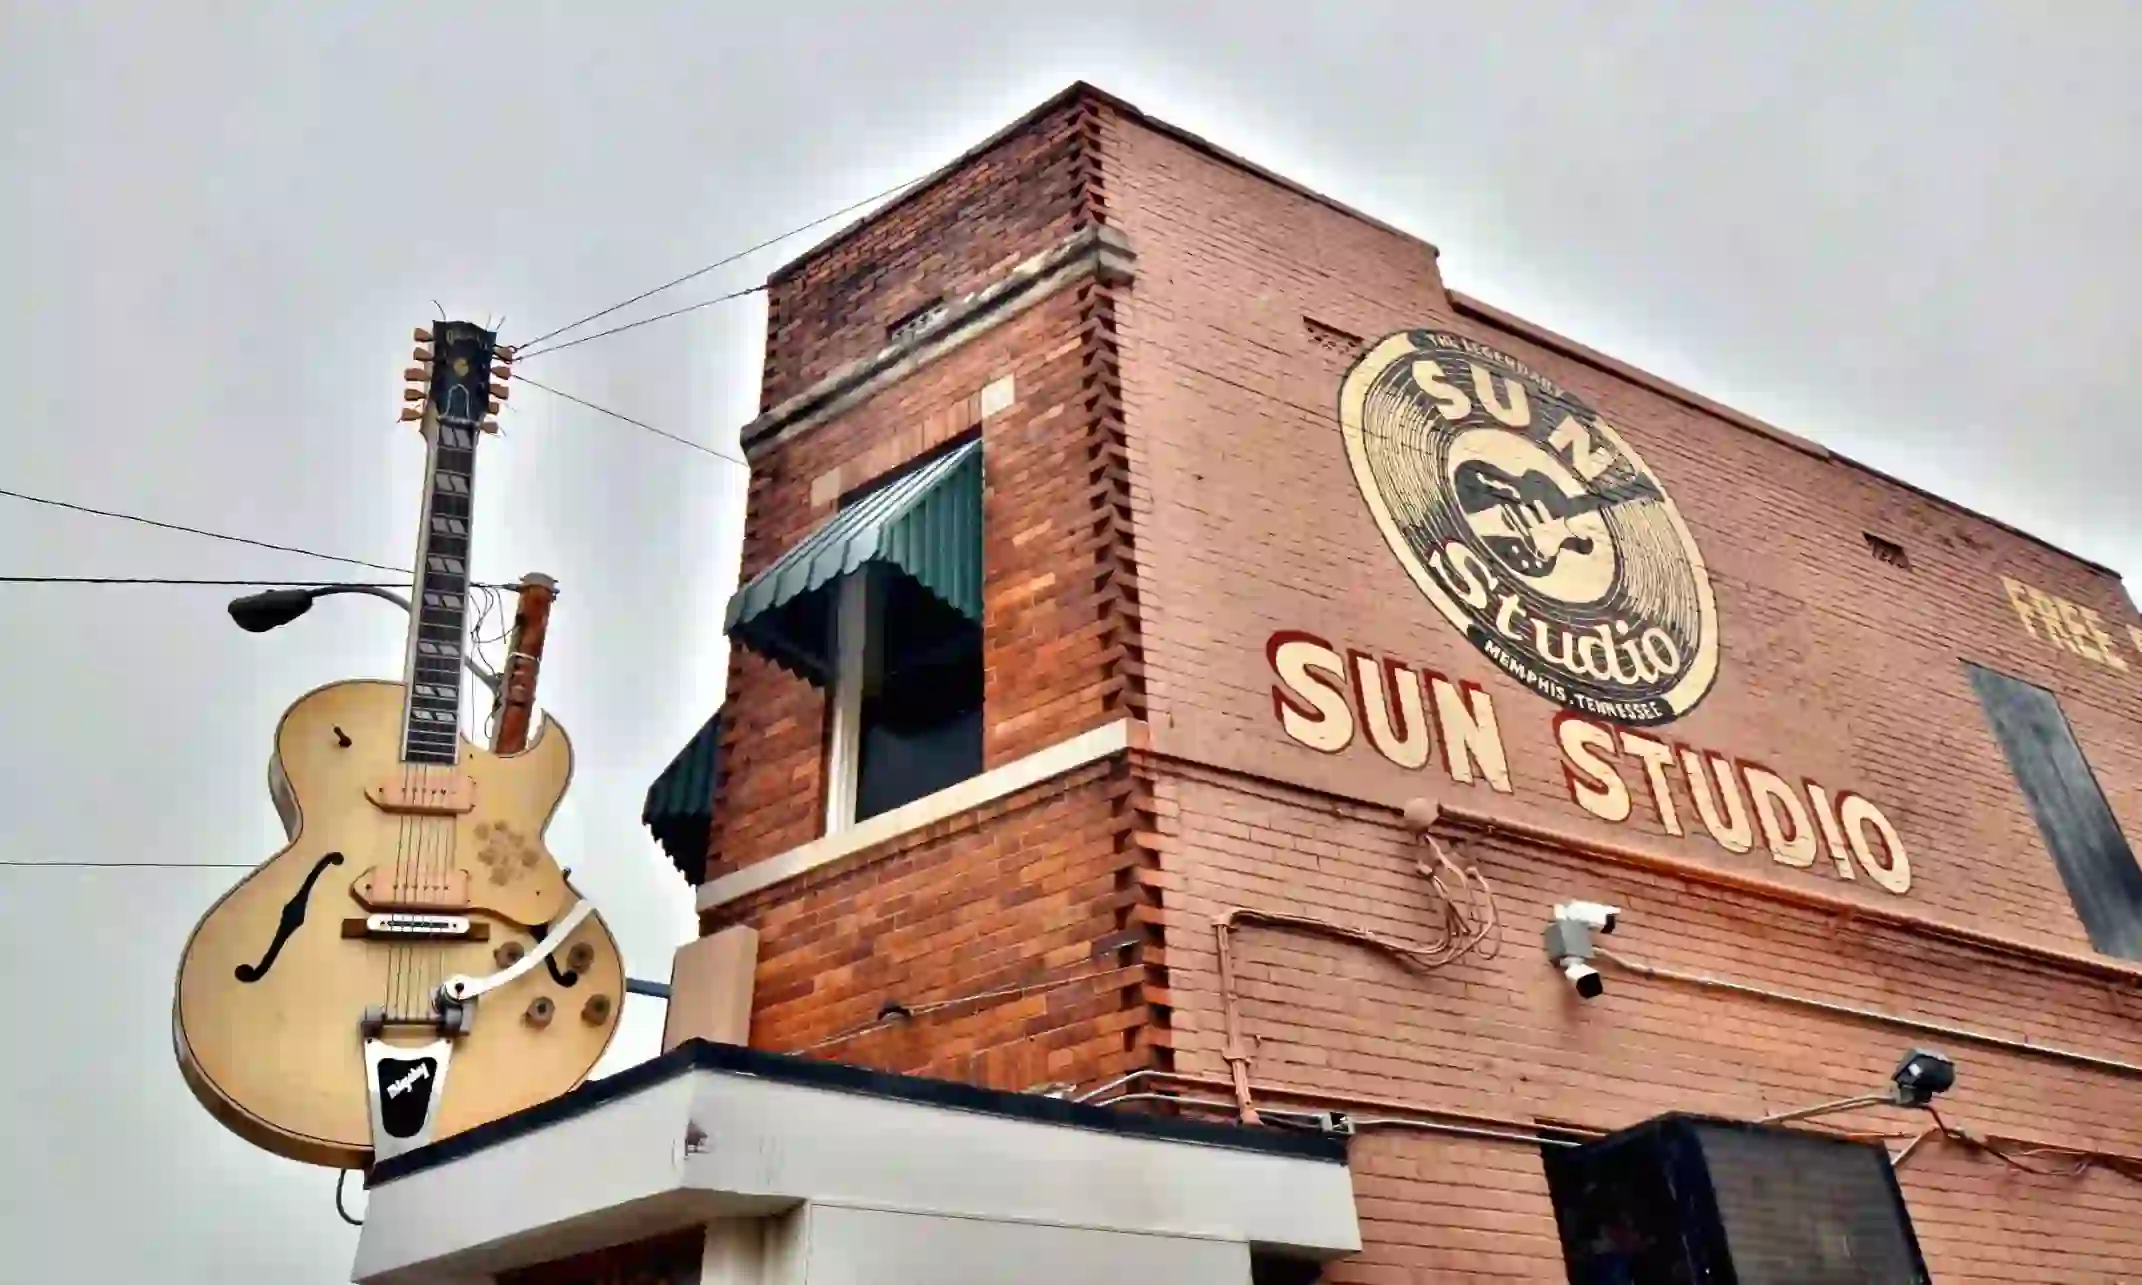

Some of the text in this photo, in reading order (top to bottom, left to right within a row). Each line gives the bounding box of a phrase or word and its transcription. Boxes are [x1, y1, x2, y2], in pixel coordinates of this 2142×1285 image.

[1412, 360, 1615, 482] SUN
[1430, 539, 1681, 685] Studio
[2001, 577, 2129, 672] FREE
[1266, 630, 1913, 895] SUN STUDIO
[1574, 693, 1663, 720] TENNESSEE
